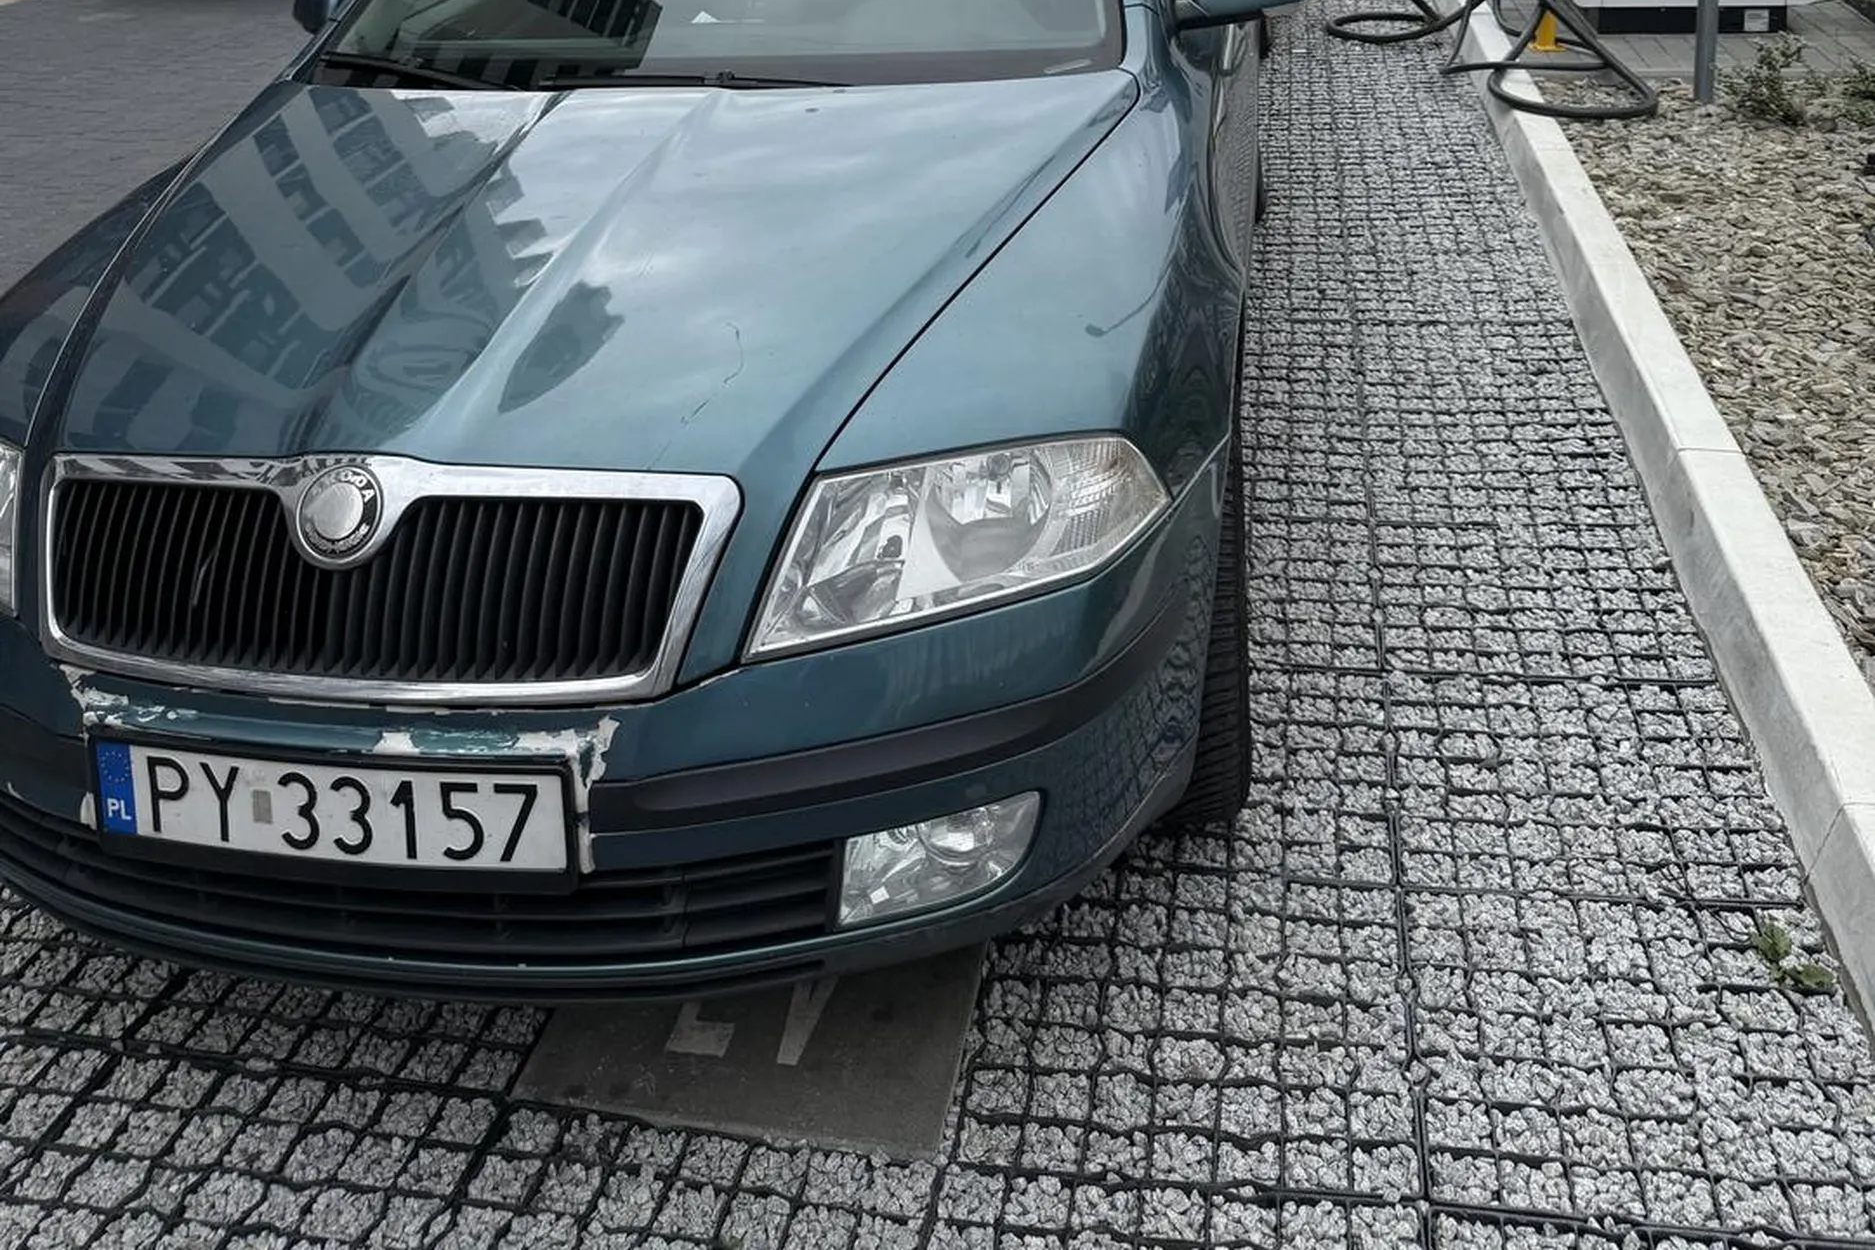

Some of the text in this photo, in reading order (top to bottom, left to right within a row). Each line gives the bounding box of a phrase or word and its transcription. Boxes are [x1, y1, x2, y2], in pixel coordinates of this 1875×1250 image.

[107, 799, 132, 821] PL
[145, 756, 537, 862] PY 33157
